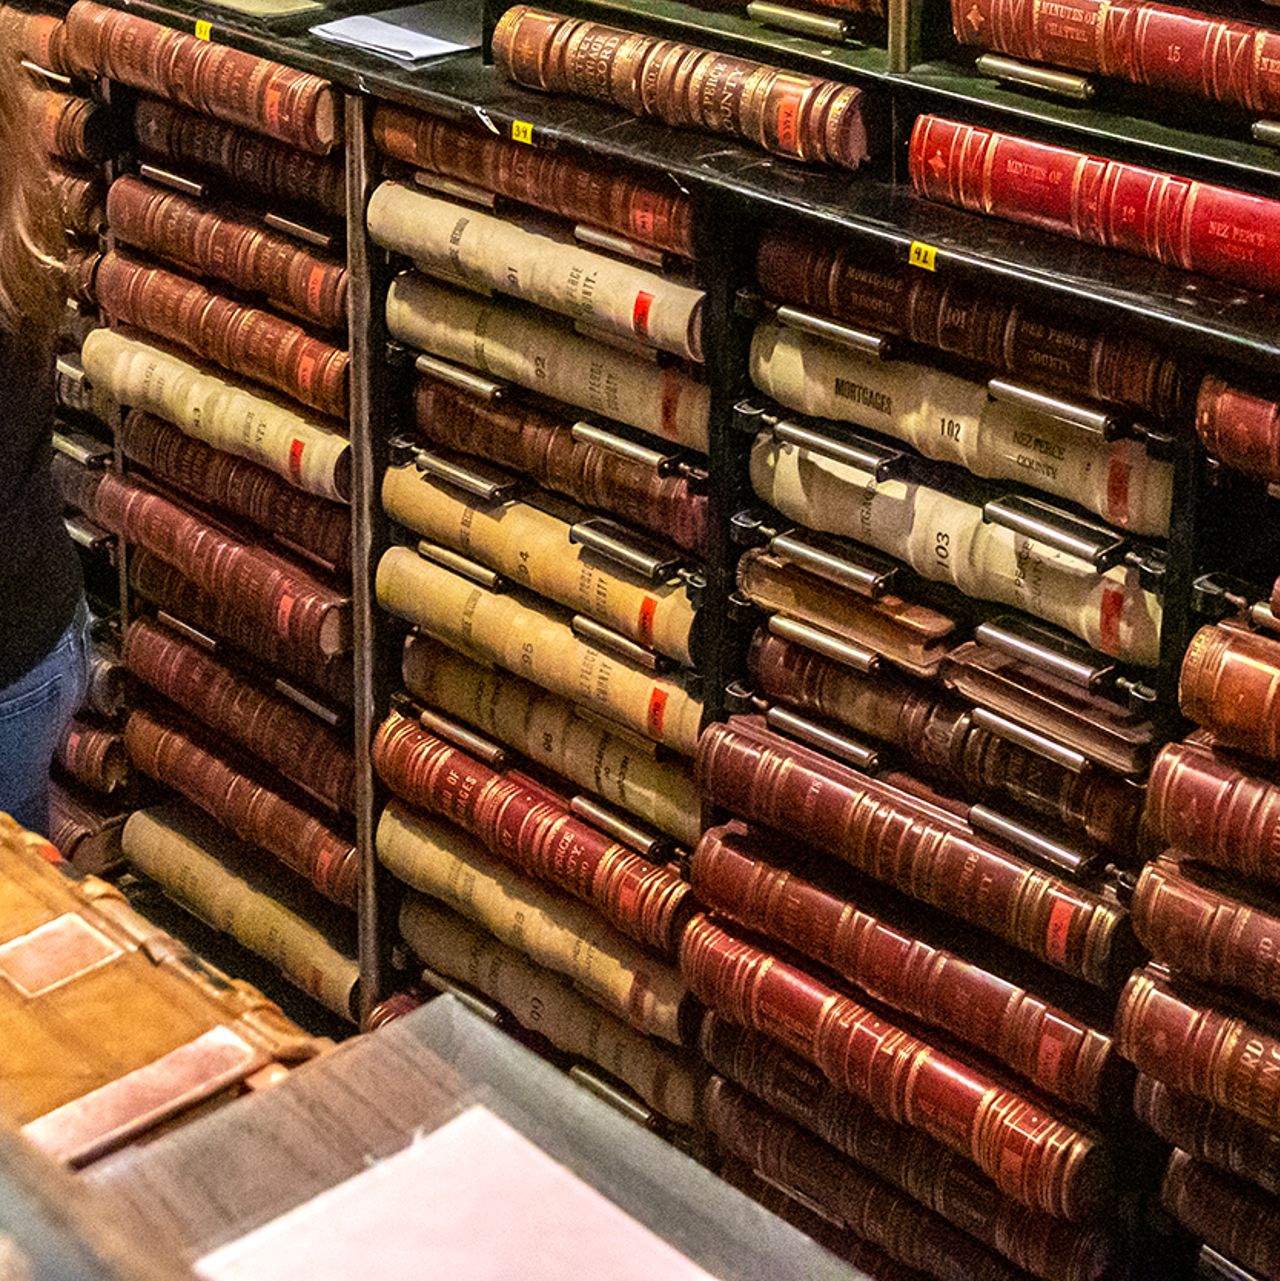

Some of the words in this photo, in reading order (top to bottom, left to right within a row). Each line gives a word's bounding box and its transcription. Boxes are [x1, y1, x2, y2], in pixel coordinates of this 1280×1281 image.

[1166, 43, 1181, 63] 15
[834, 377, 892, 414] MORTGAGES
[940, 418, 961, 441] 102
[937, 532, 951, 567] 103
